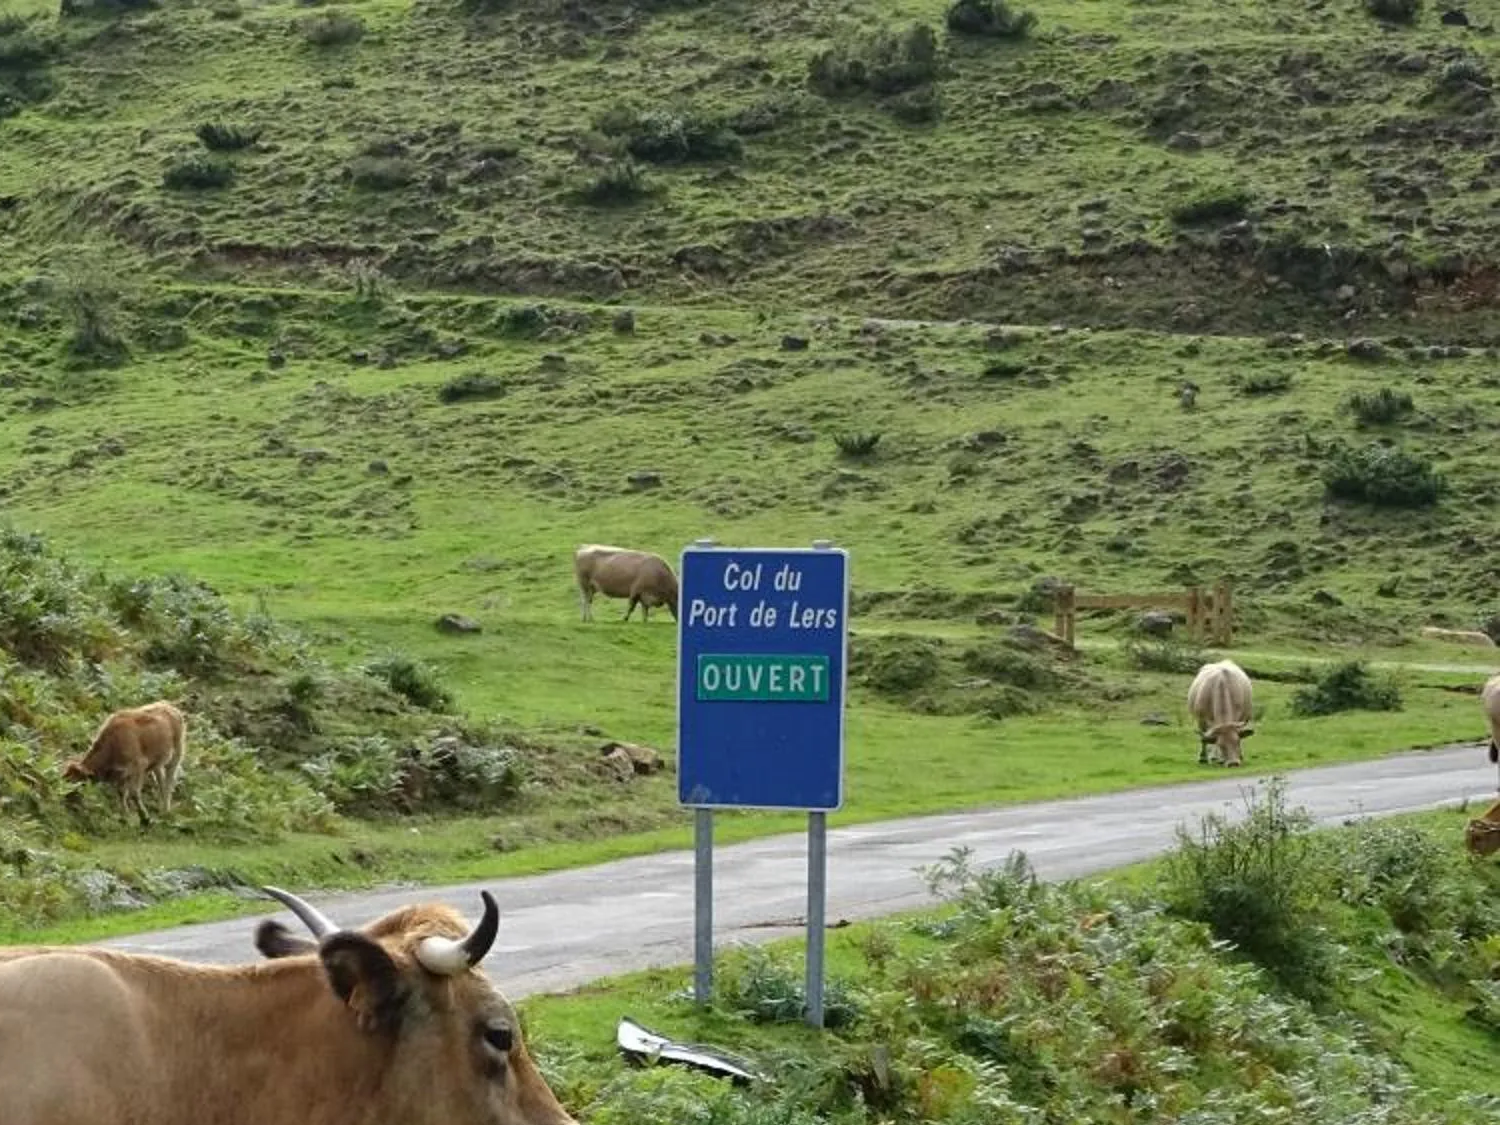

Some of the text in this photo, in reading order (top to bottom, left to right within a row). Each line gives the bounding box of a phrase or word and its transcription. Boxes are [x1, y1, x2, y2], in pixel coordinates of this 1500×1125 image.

[723, 563, 802, 591] Col du
[688, 600, 838, 629] Port de Lers
[702, 664, 825, 693] OUVERT
